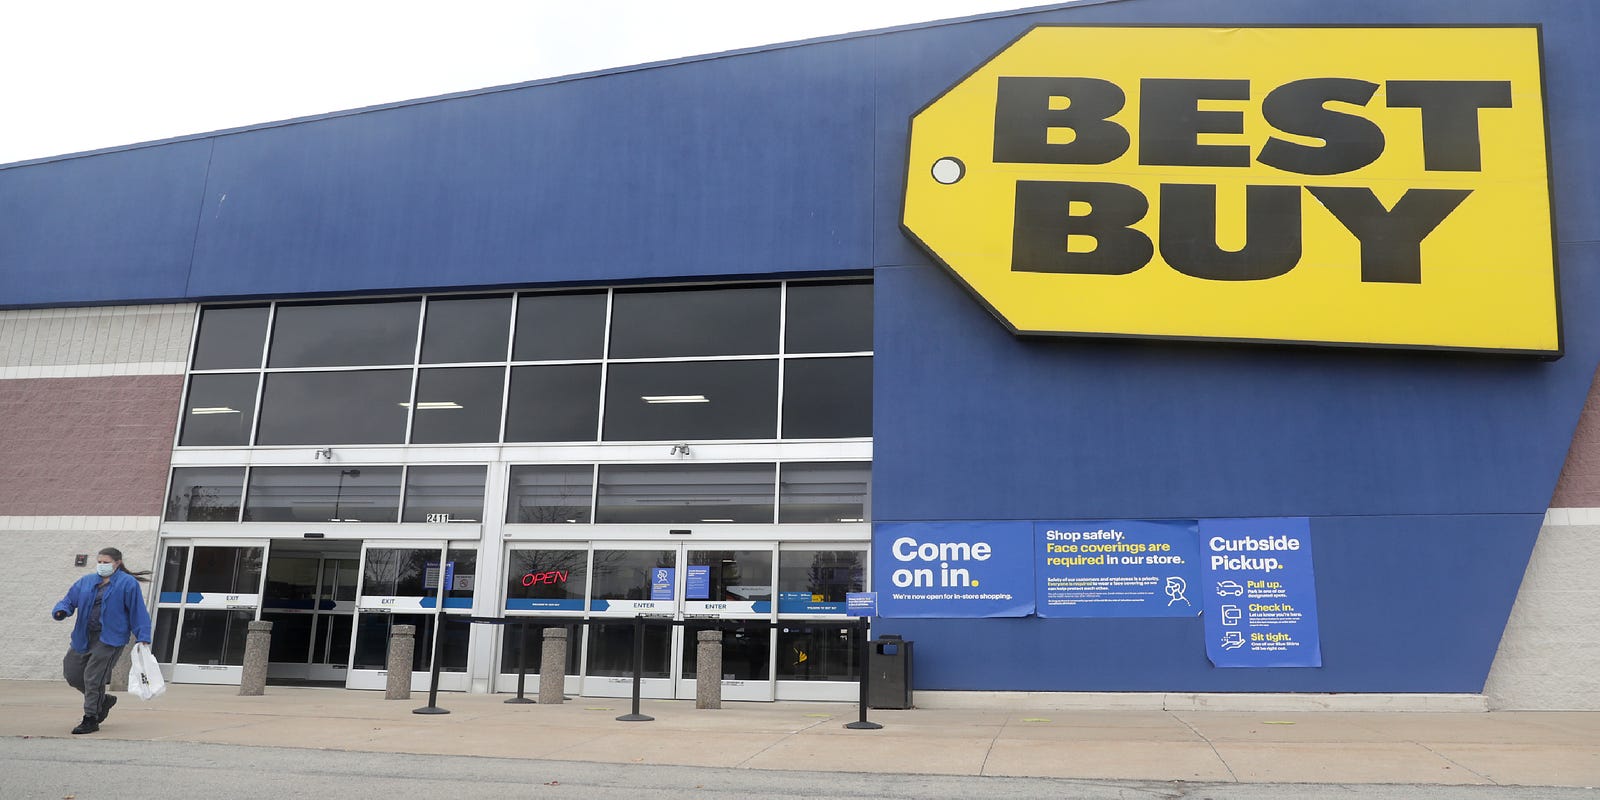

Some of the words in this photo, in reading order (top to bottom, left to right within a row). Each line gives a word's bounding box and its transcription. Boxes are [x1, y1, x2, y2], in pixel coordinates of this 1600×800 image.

[992, 76, 1513, 175] BEST
[1011, 180, 1475, 284] BUY
[426, 513, 448, 523] 2411
[1046, 530, 1081, 542] Shop
[1083, 529, 1125, 541] safely.
[892, 537, 991, 561] Come
[1046, 543, 1078, 553] Face
[1080, 542, 1146, 554] coverings
[1148, 543, 1170, 552] are
[1209, 536, 1300, 551] Curbside
[1047, 555, 1104, 567] required
[1107, 555, 1119, 564] in
[1121, 555, 1144, 564] our
[1146, 554, 1185, 564] store.
[1211, 555, 1283, 572] Pickup.
[522, 570, 568, 586] OPEN
[892, 568, 933, 587] on
[941, 562, 979, 587] in.
[1247, 580, 1265, 588] Pull
[1267, 581, 1282, 589] up.
[926, 593, 943, 601] open
[979, 592, 1013, 601] shopping.
[1249, 603, 1280, 611] Check
[1282, 603, 1294, 611] in.
[1251, 632, 1264, 640] Sit
[1266, 632, 1291, 642] tight.
